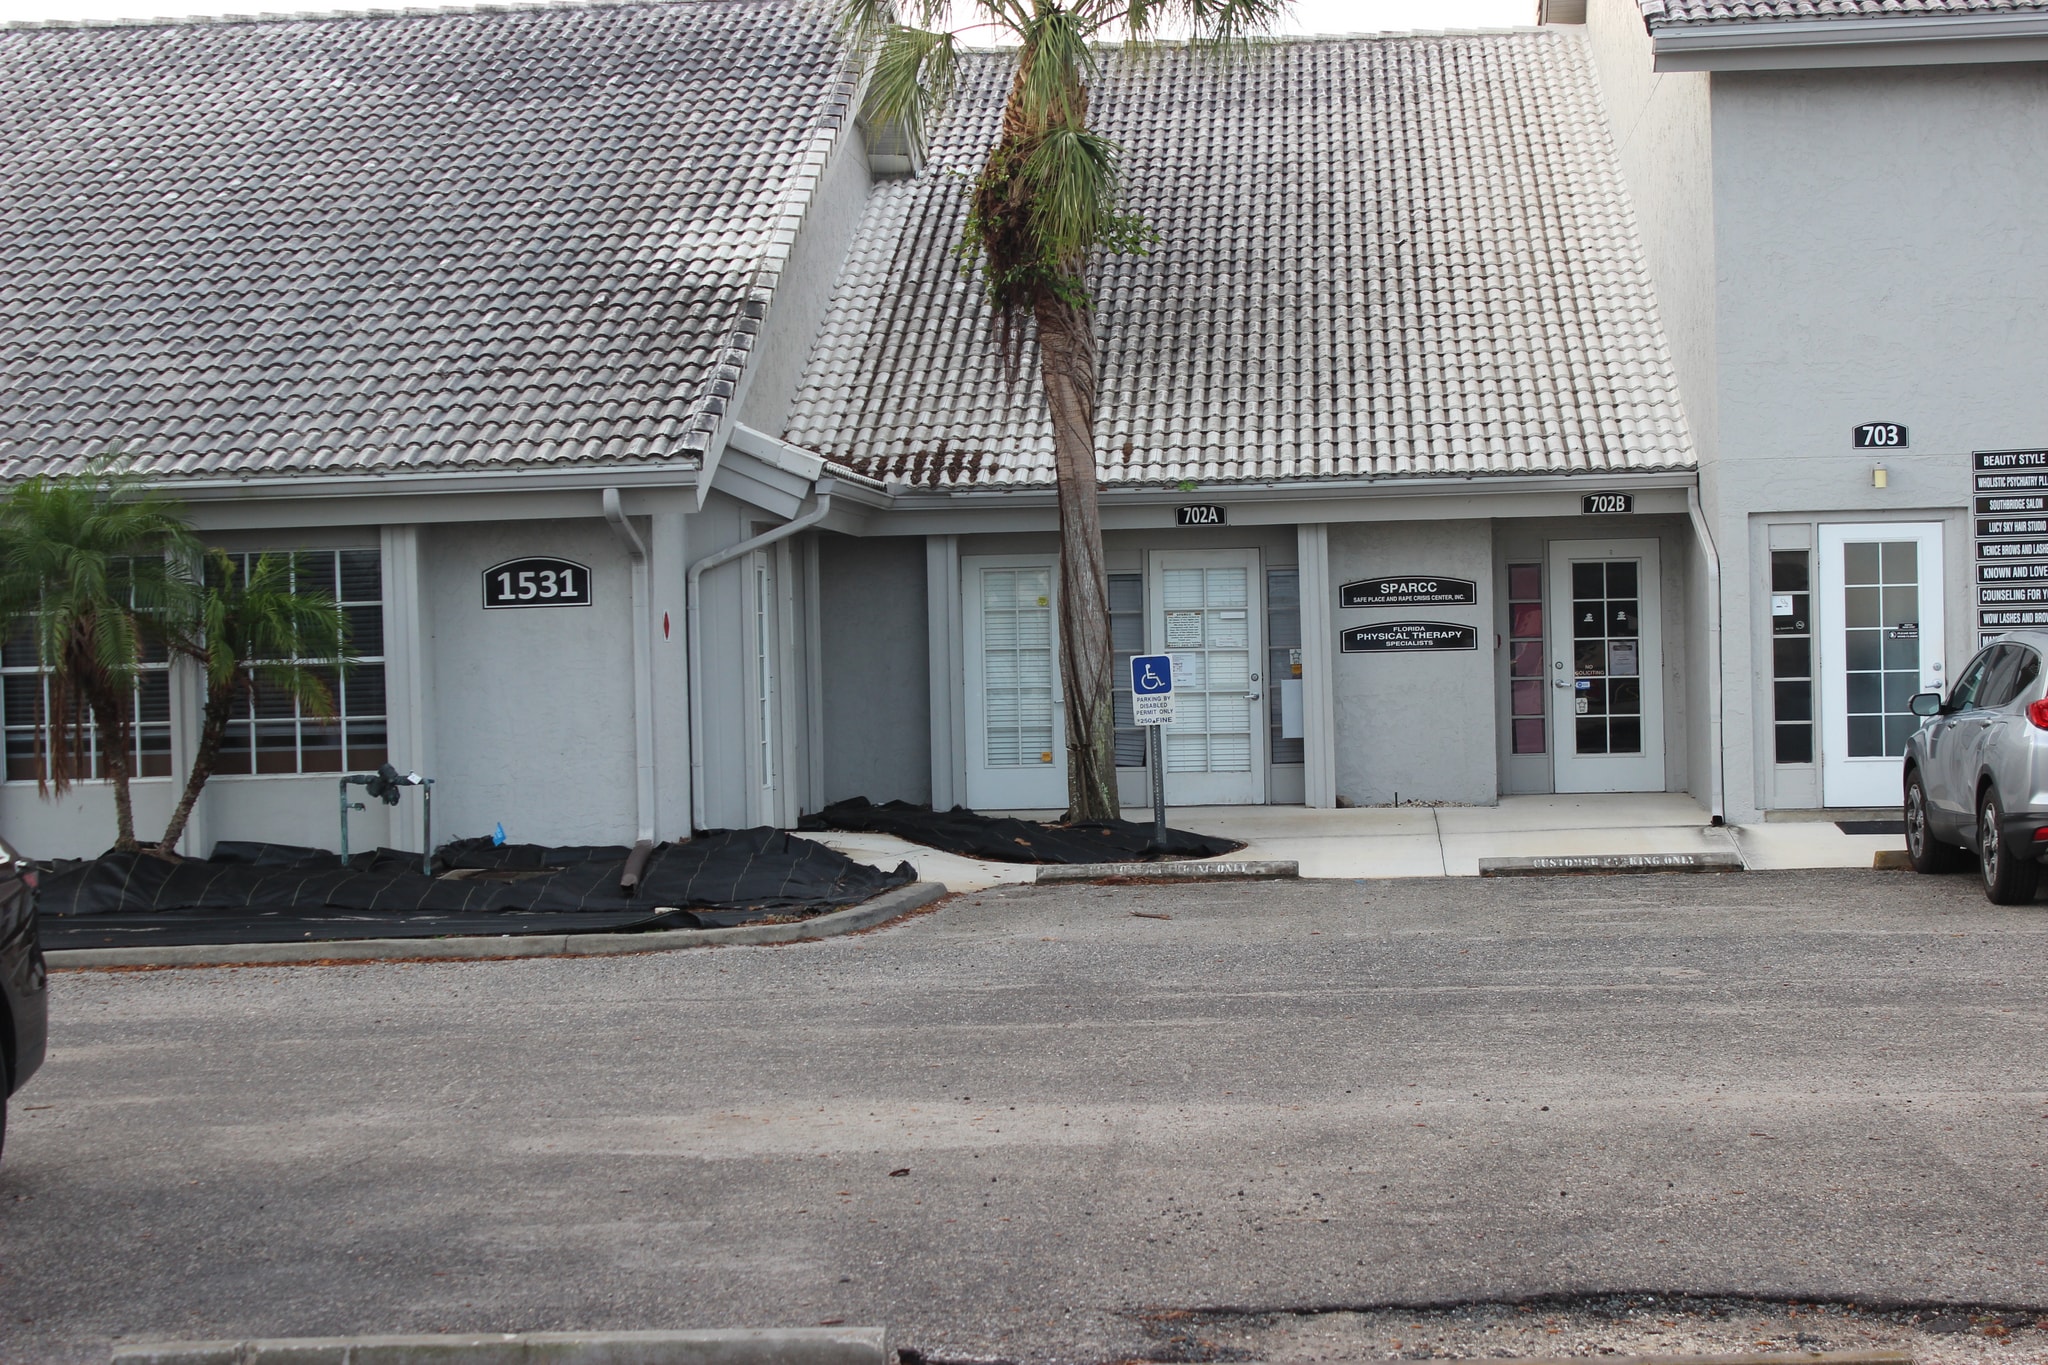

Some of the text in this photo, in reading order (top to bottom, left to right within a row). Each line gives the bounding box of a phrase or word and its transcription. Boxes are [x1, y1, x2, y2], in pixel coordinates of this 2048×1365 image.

[1862, 425, 1899, 446] 703
[1983, 453, 2046, 467] BEAUTY STYLE
[1977, 476, 2006, 488] WHOLISTIC
[2006, 475, 2038, 487] PSYCHIATRY
[1590, 495, 1625, 513] 702B
[1989, 498, 2044, 511] SOUTHBRIDGE SALON
[1183, 506, 1219, 524] 702A
[1988, 520, 2047, 533] LUCY SKY HAIR STUDIO
[1982, 545, 2002, 556] VENICE
[2001, 544, 2021, 556] BROWS
[2021, 543, 2033, 555] AND
[1983, 567, 2011, 579] KNOWN
[2012, 566, 2028, 578] AND
[497, 568, 579, 600] 1531
[1380, 582, 1437, 593] SPARCC
[1981, 589, 2026, 602] COUNSELING
[2027, 589, 2042, 601] FOR
[1982, 613, 1999, 625] WOW
[1999, 612, 2021, 624] LASHES
[2021, 612, 2034, 624] AND
[1357, 631, 1462, 641] PHYSICAL THERAPY
[1663, 855, 1695, 865] ONLY
[1217, 863, 1248, 873] ONLY
